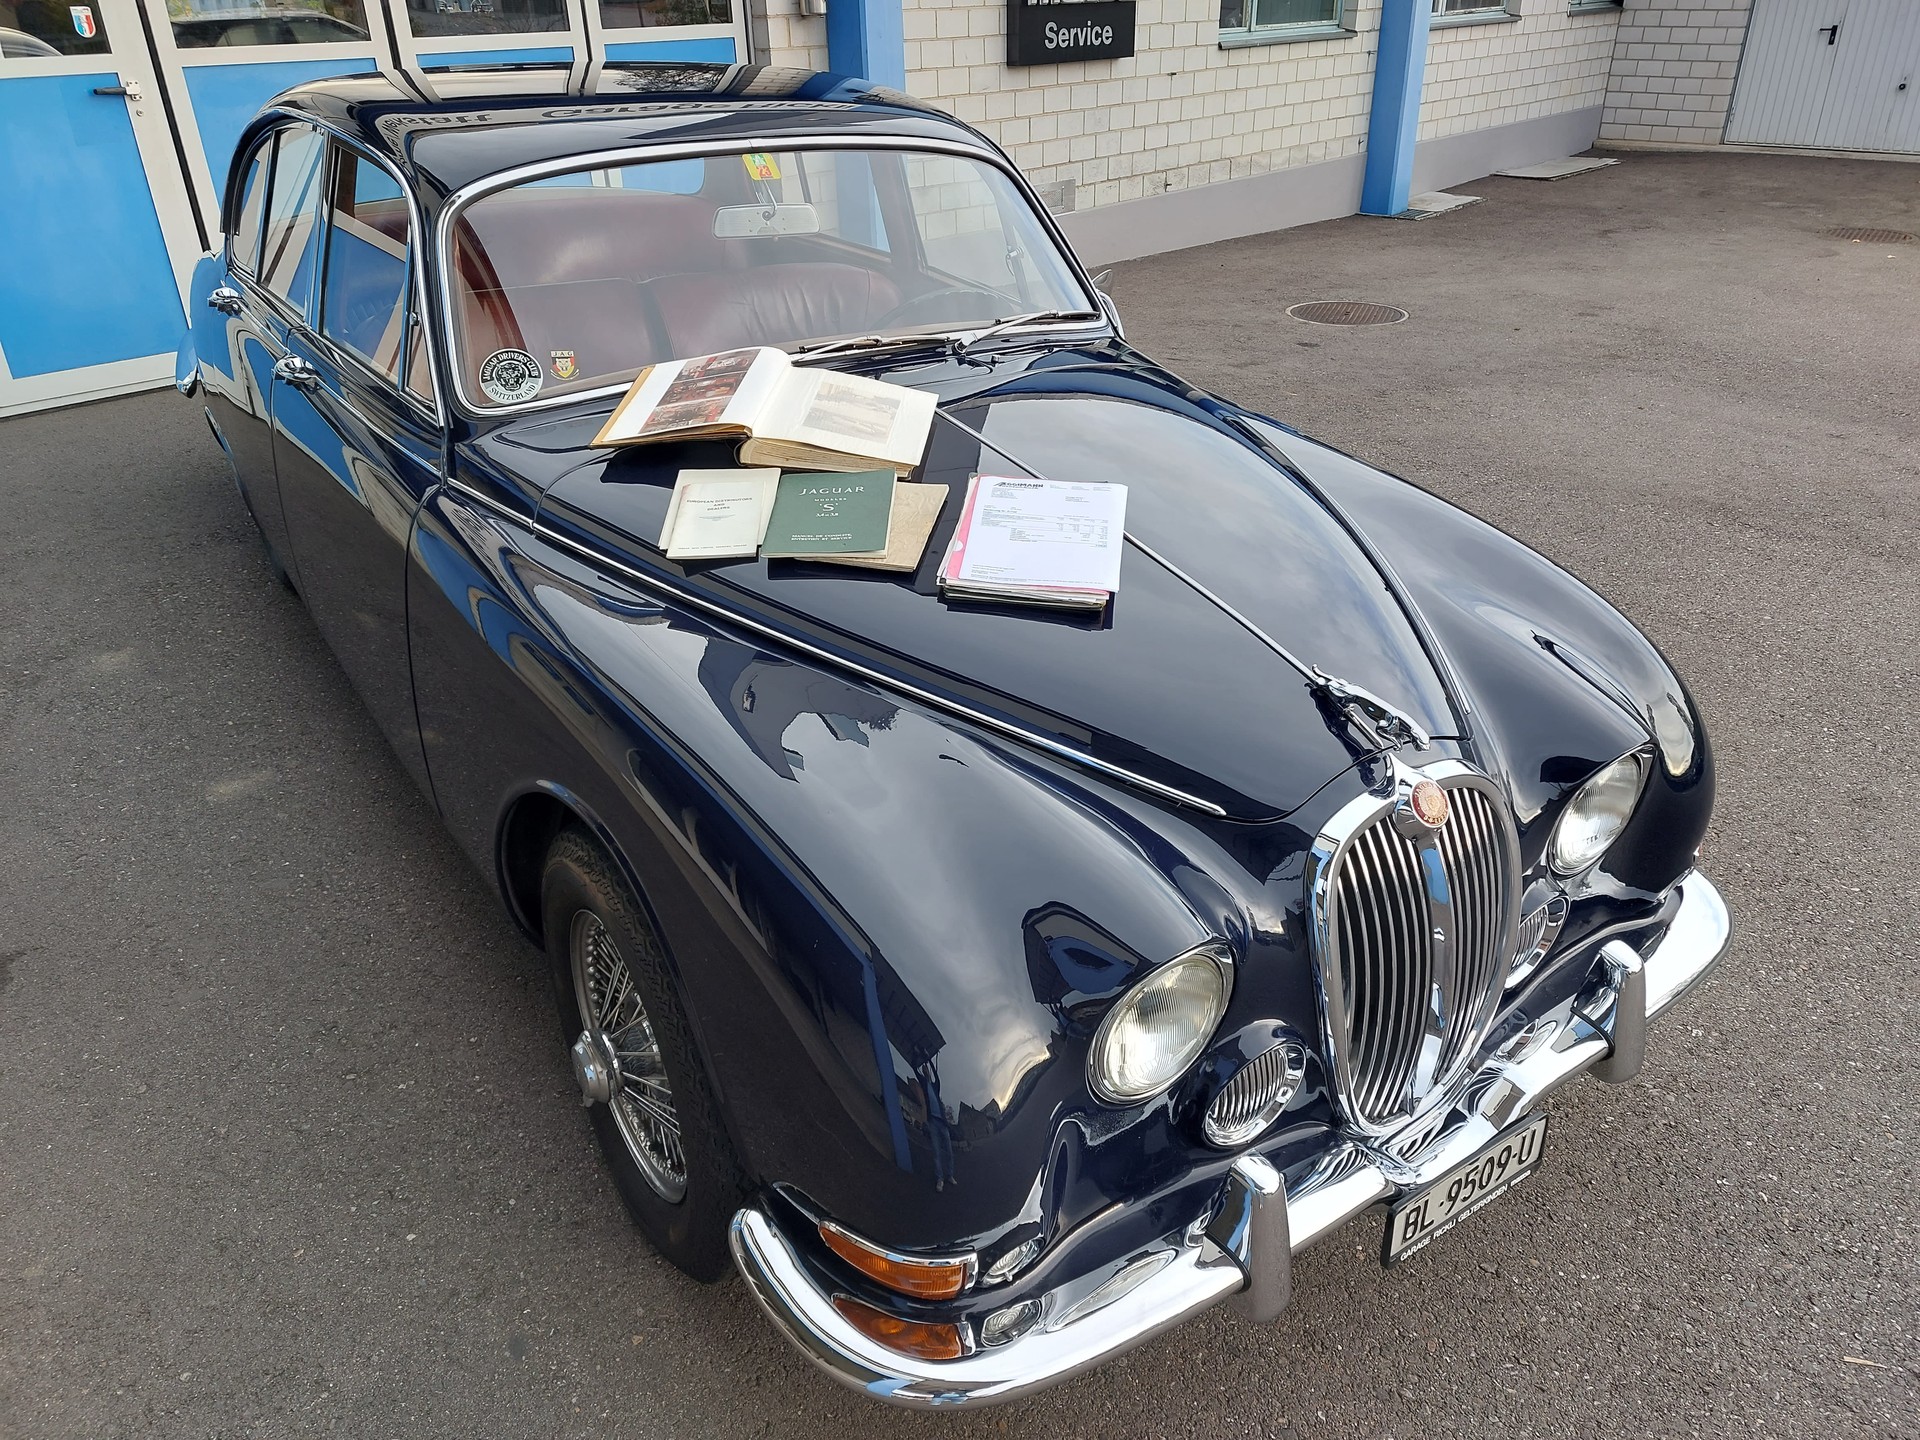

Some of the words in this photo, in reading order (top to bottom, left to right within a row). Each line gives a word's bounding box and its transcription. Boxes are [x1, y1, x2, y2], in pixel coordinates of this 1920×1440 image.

[1044, 20, 1113, 49] Service
[482, 357, 499, 381] JAGUAR
[526, 359, 539, 377] CLUB
[489, 384, 536, 401] SWITZERLAND
[799, 486, 865, 496] JAGUAR
[1400, 1236, 1432, 1261] GARAGE
[1433, 1220, 1457, 1241] RICKLI
[1458, 1184, 1508, 1222] GELTERKINDEN
